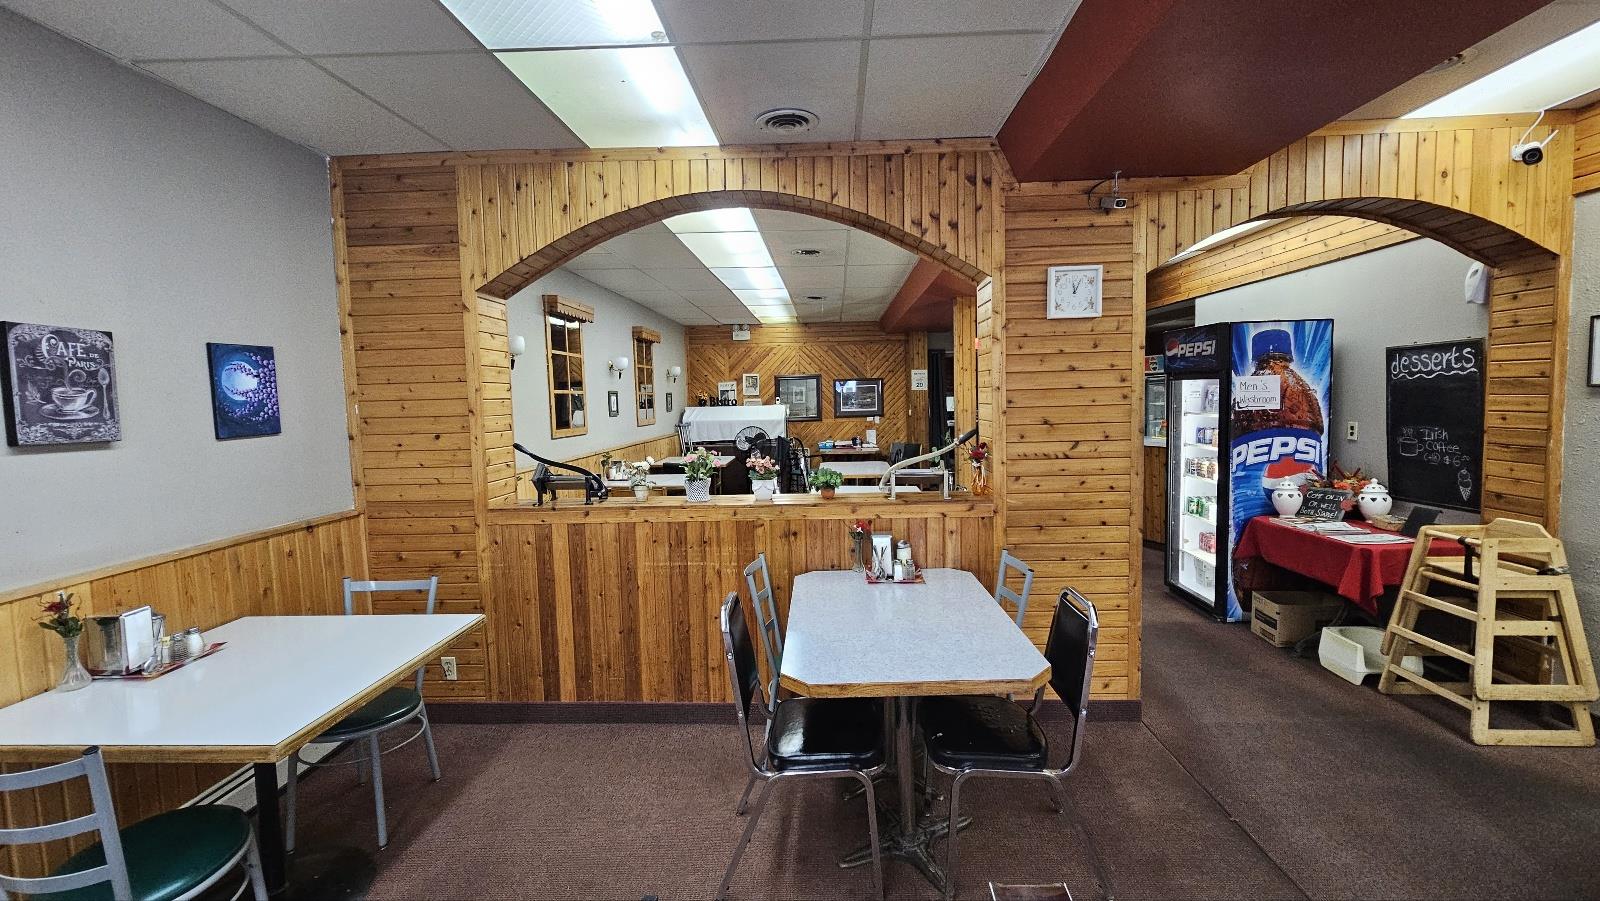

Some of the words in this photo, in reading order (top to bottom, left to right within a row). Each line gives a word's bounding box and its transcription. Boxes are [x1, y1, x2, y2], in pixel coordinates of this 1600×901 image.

[1177, 340, 1216, 358] PEPSI
[65, 356, 97, 370] PARIS
[1391, 346, 1475, 375] desserts
[1421, 428, 1449, 441] Irish
[1232, 437, 1320, 473] PEPSI
